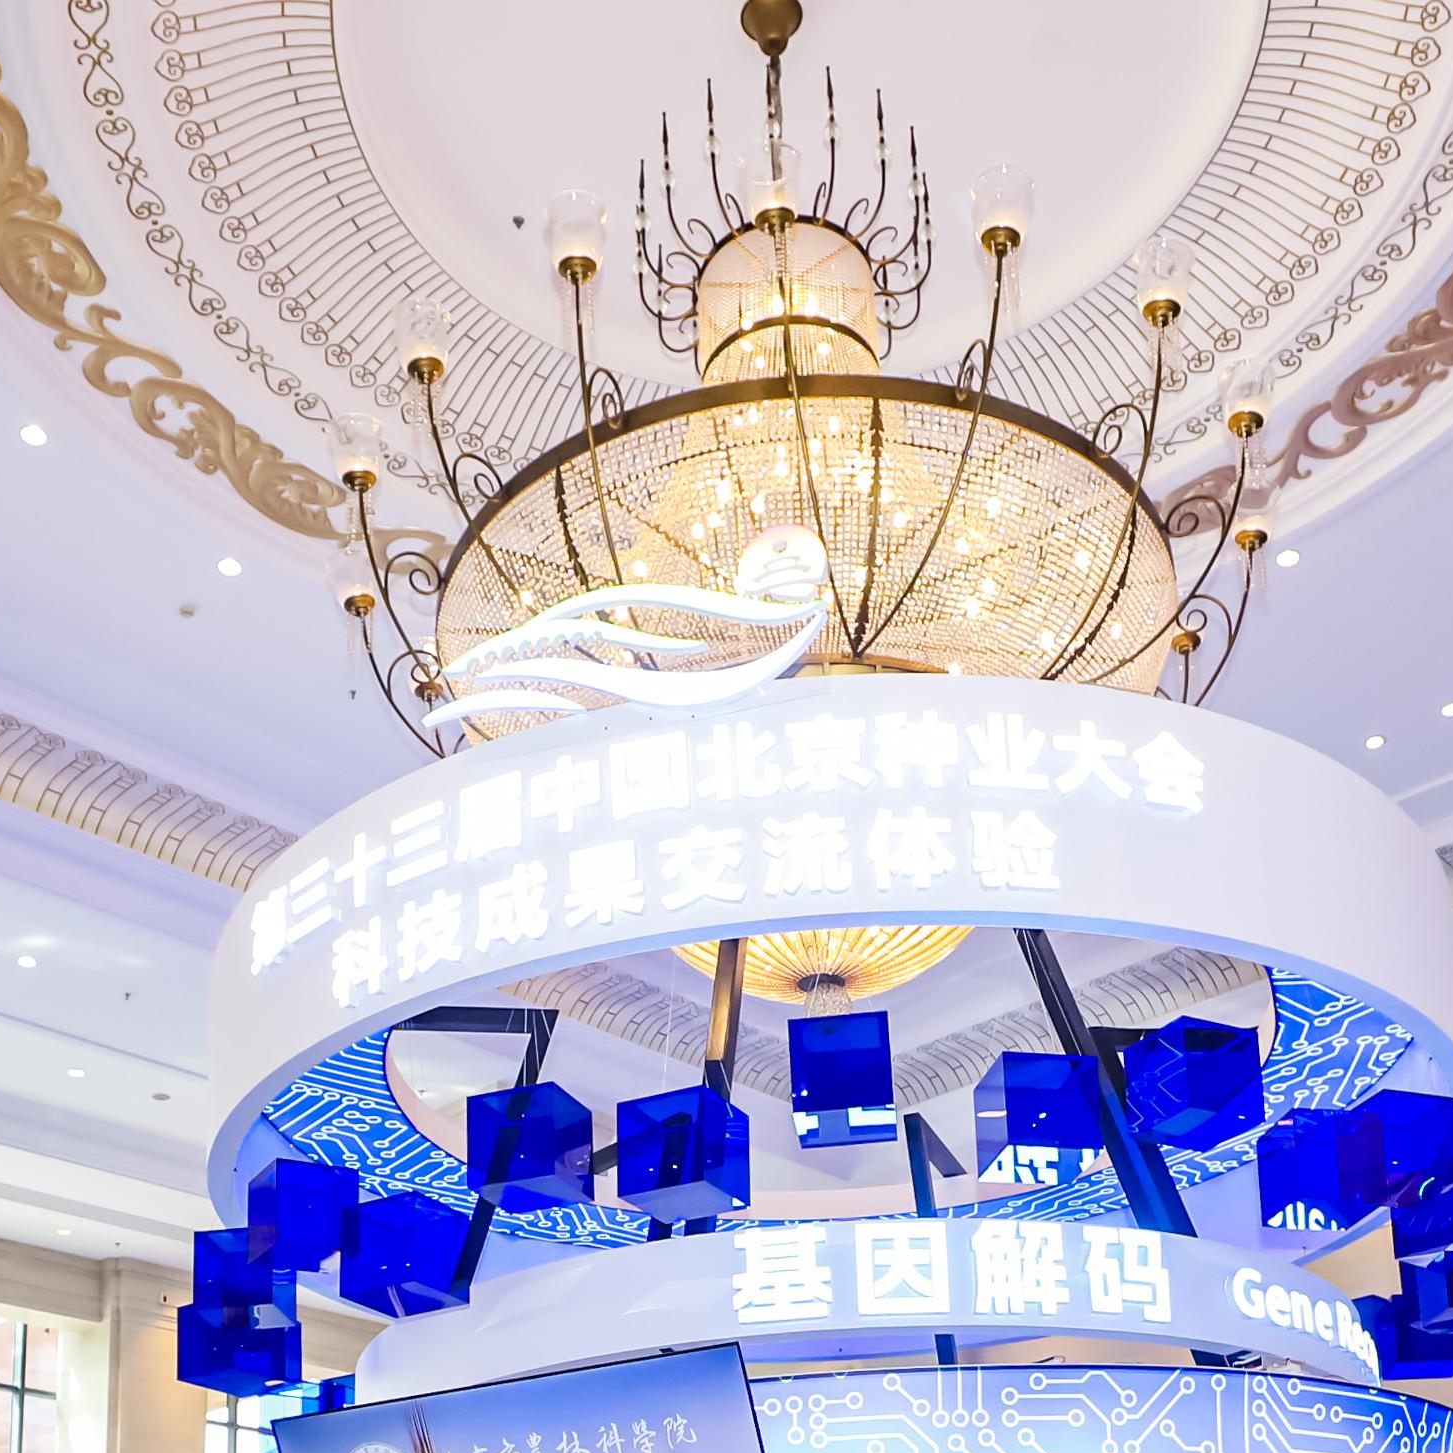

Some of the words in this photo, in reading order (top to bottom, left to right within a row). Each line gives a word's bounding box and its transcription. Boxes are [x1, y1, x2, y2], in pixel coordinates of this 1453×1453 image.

[250, 709, 1204, 975] 第三十三届中国北京种业大会
[332, 805, 1060, 1008] 科技成果交流体验
[733, 1221, 1171, 1324] 基因解码
[1232, 1267, 1334, 1341] Gene
